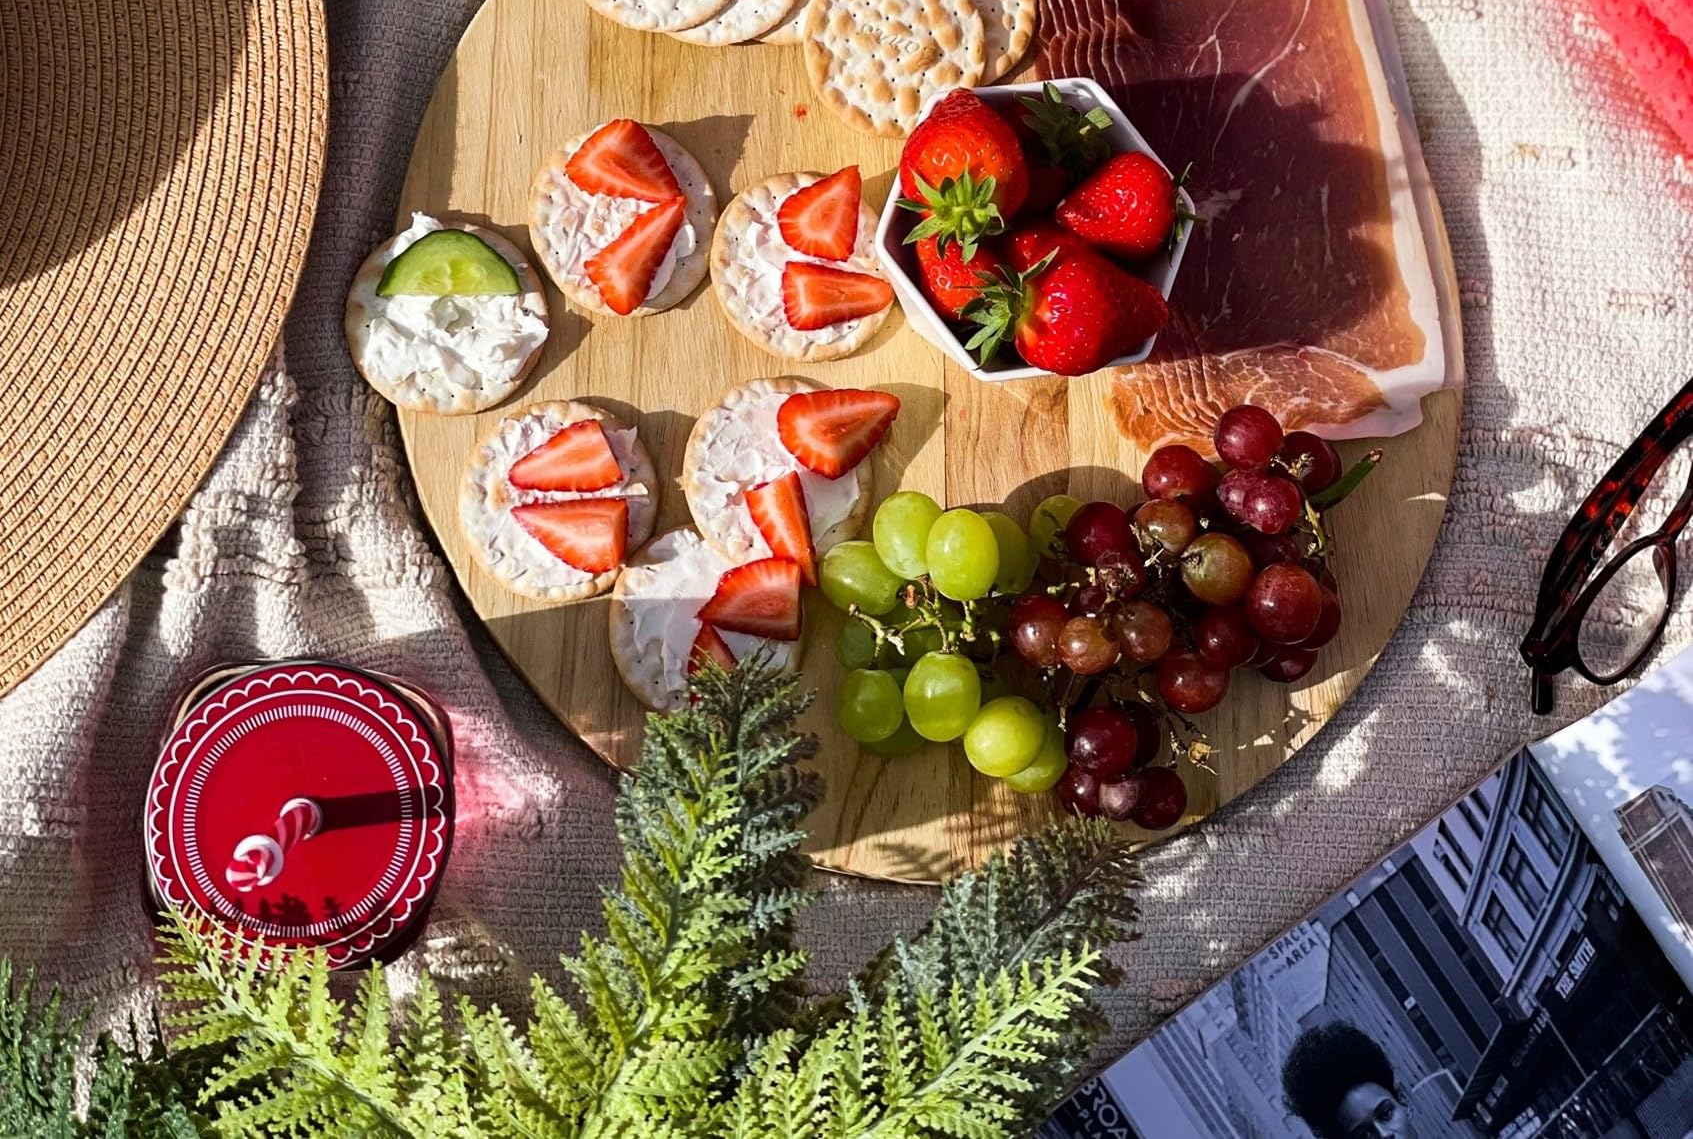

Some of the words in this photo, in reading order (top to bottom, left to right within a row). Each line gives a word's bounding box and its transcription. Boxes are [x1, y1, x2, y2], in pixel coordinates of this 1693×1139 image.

[1267, 923, 1309, 960] SPACE
[1285, 937, 1318, 970] AREA
[1568, 936, 1596, 980] SMITH
